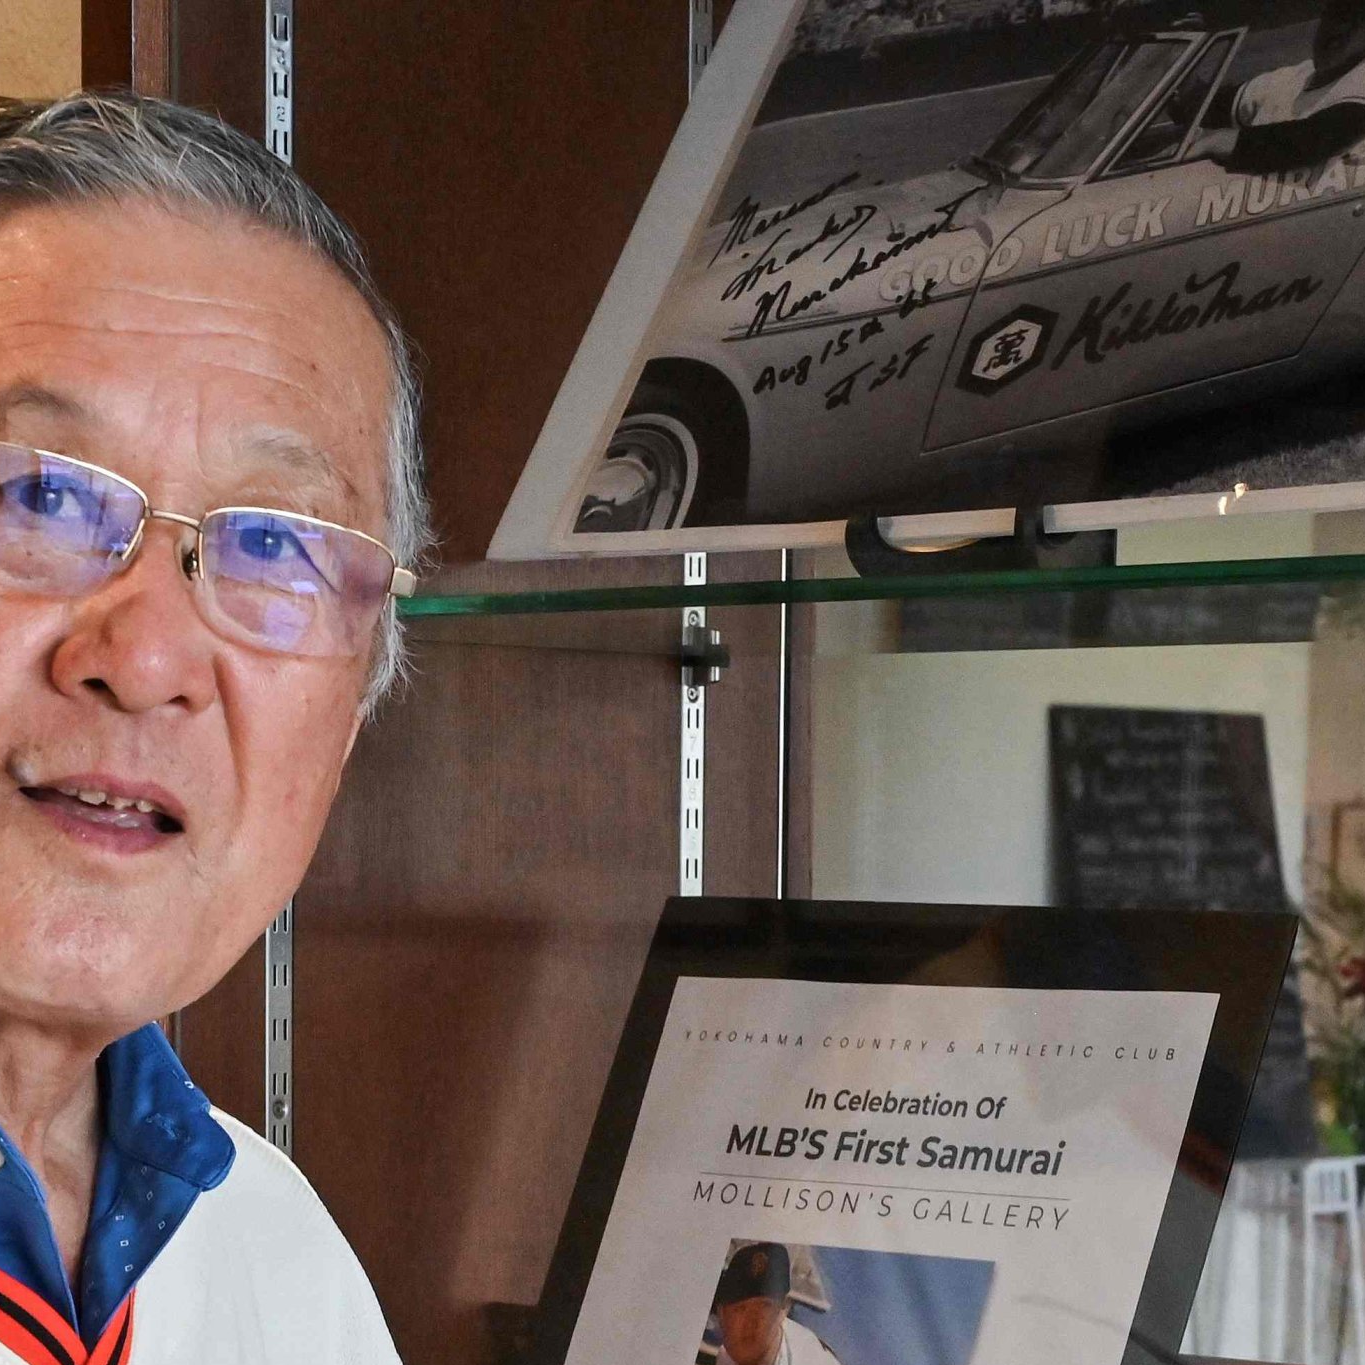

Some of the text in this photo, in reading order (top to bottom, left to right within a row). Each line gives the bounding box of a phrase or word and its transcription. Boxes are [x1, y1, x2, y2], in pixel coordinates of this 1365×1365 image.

[880, 225, 1029, 301] GOOD
[1038, 200, 1169, 266] LUCK
[1052, 262, 1324, 370] Kikkoman
[683, 1030, 1177, 1061] YOKOHAMA COUNTRY & ATHLETIC CLUB
[804, 1087, 1008, 1120] In Celebration Of
[726, 1125, 1067, 1177] MLB'S First Samurai
[693, 1180, 1071, 1231] MOLLISON'S GALLERY
